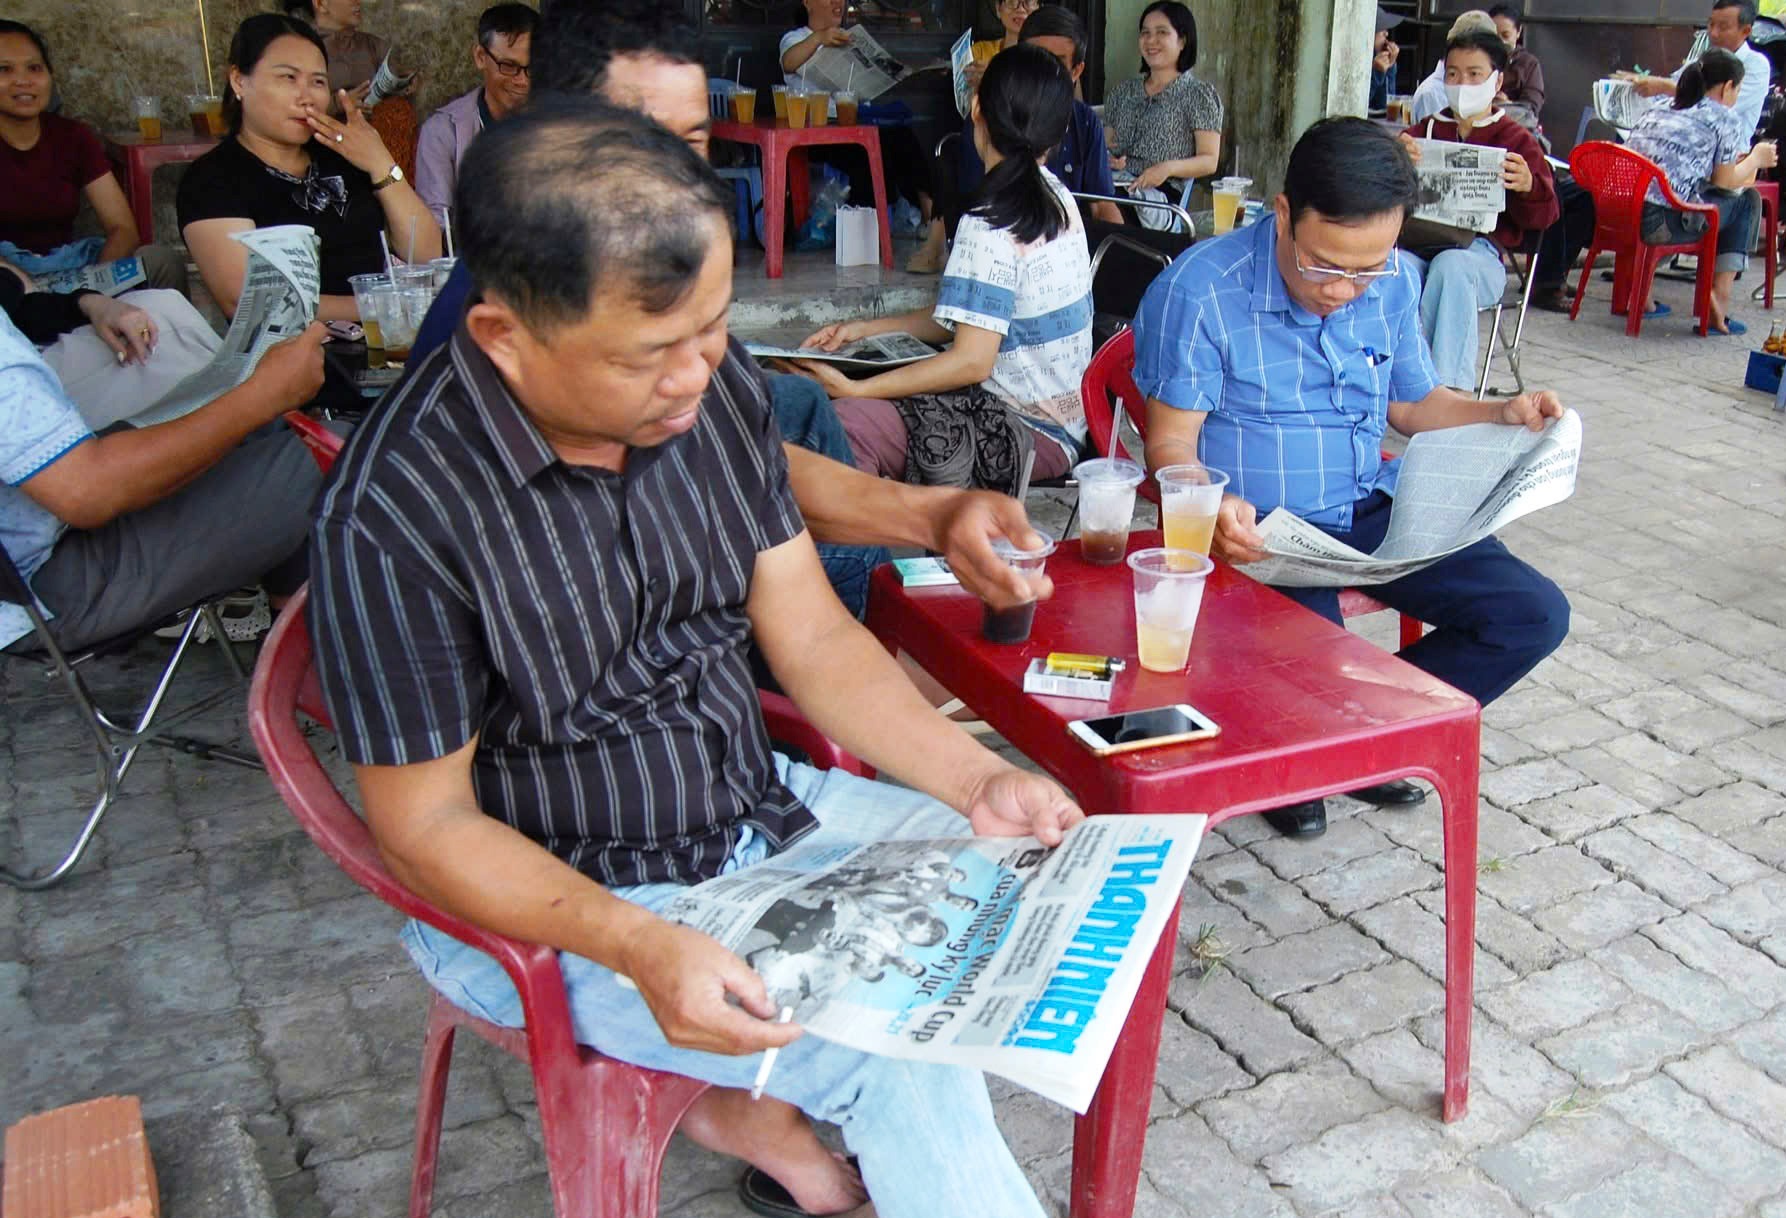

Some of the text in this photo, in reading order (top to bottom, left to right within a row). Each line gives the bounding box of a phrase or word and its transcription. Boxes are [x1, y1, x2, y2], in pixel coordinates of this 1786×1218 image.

[1064, 839, 1174, 962] THANH
[942, 951, 996, 1007] World
[911, 1010, 956, 1042] Cup
